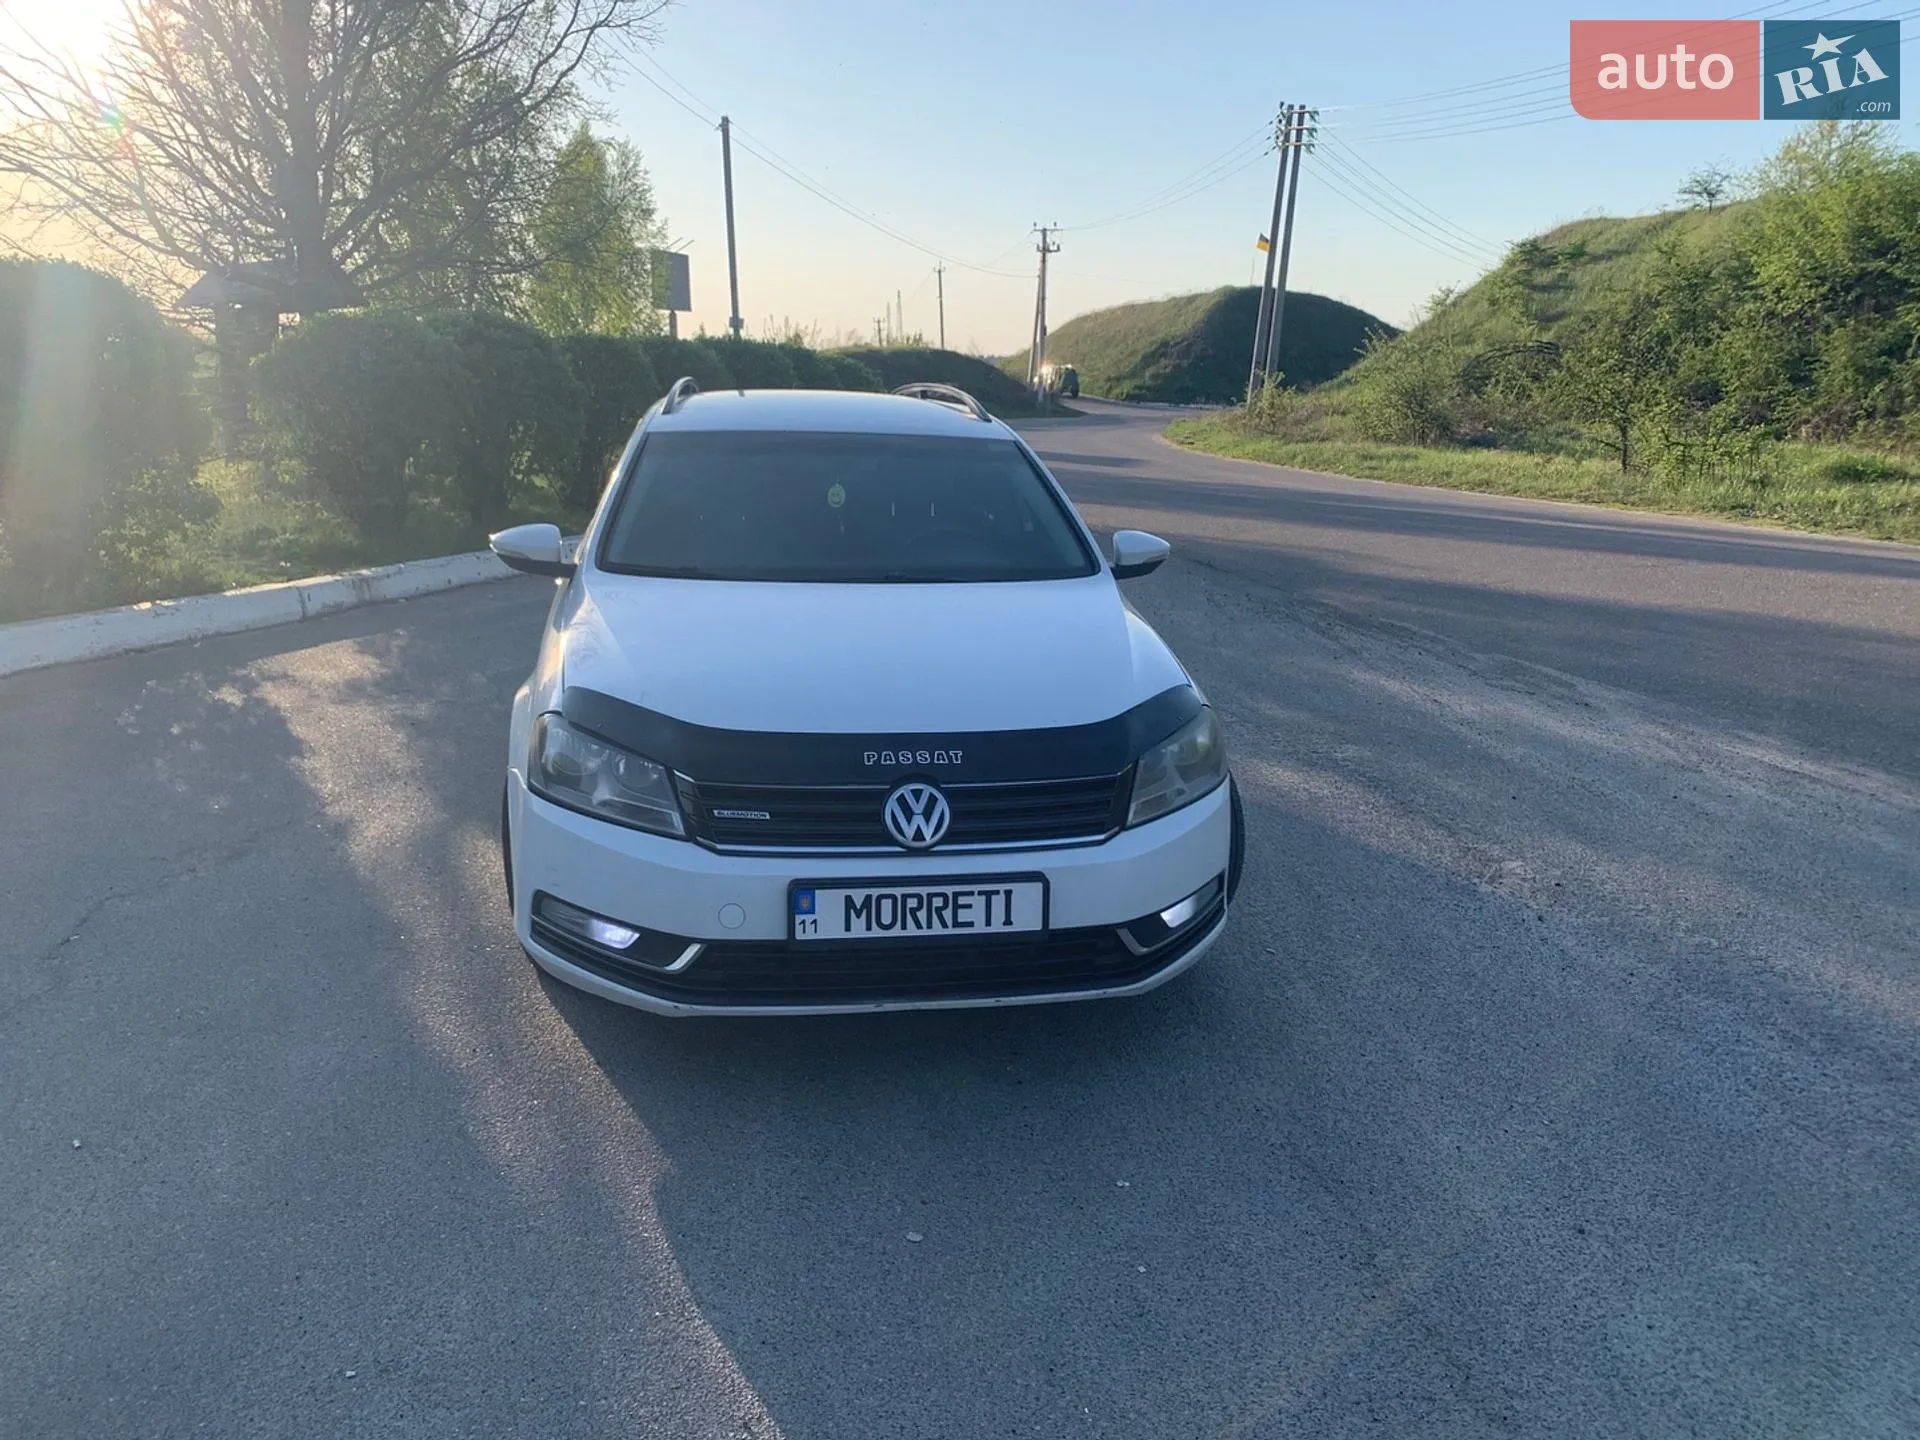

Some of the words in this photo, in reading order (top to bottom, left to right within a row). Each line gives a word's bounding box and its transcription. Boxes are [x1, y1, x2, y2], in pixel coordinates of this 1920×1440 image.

[864, 750, 963, 765] PASSAT
[844, 889, 1013, 932] MORRETI
[798, 918, 818, 935] 11
